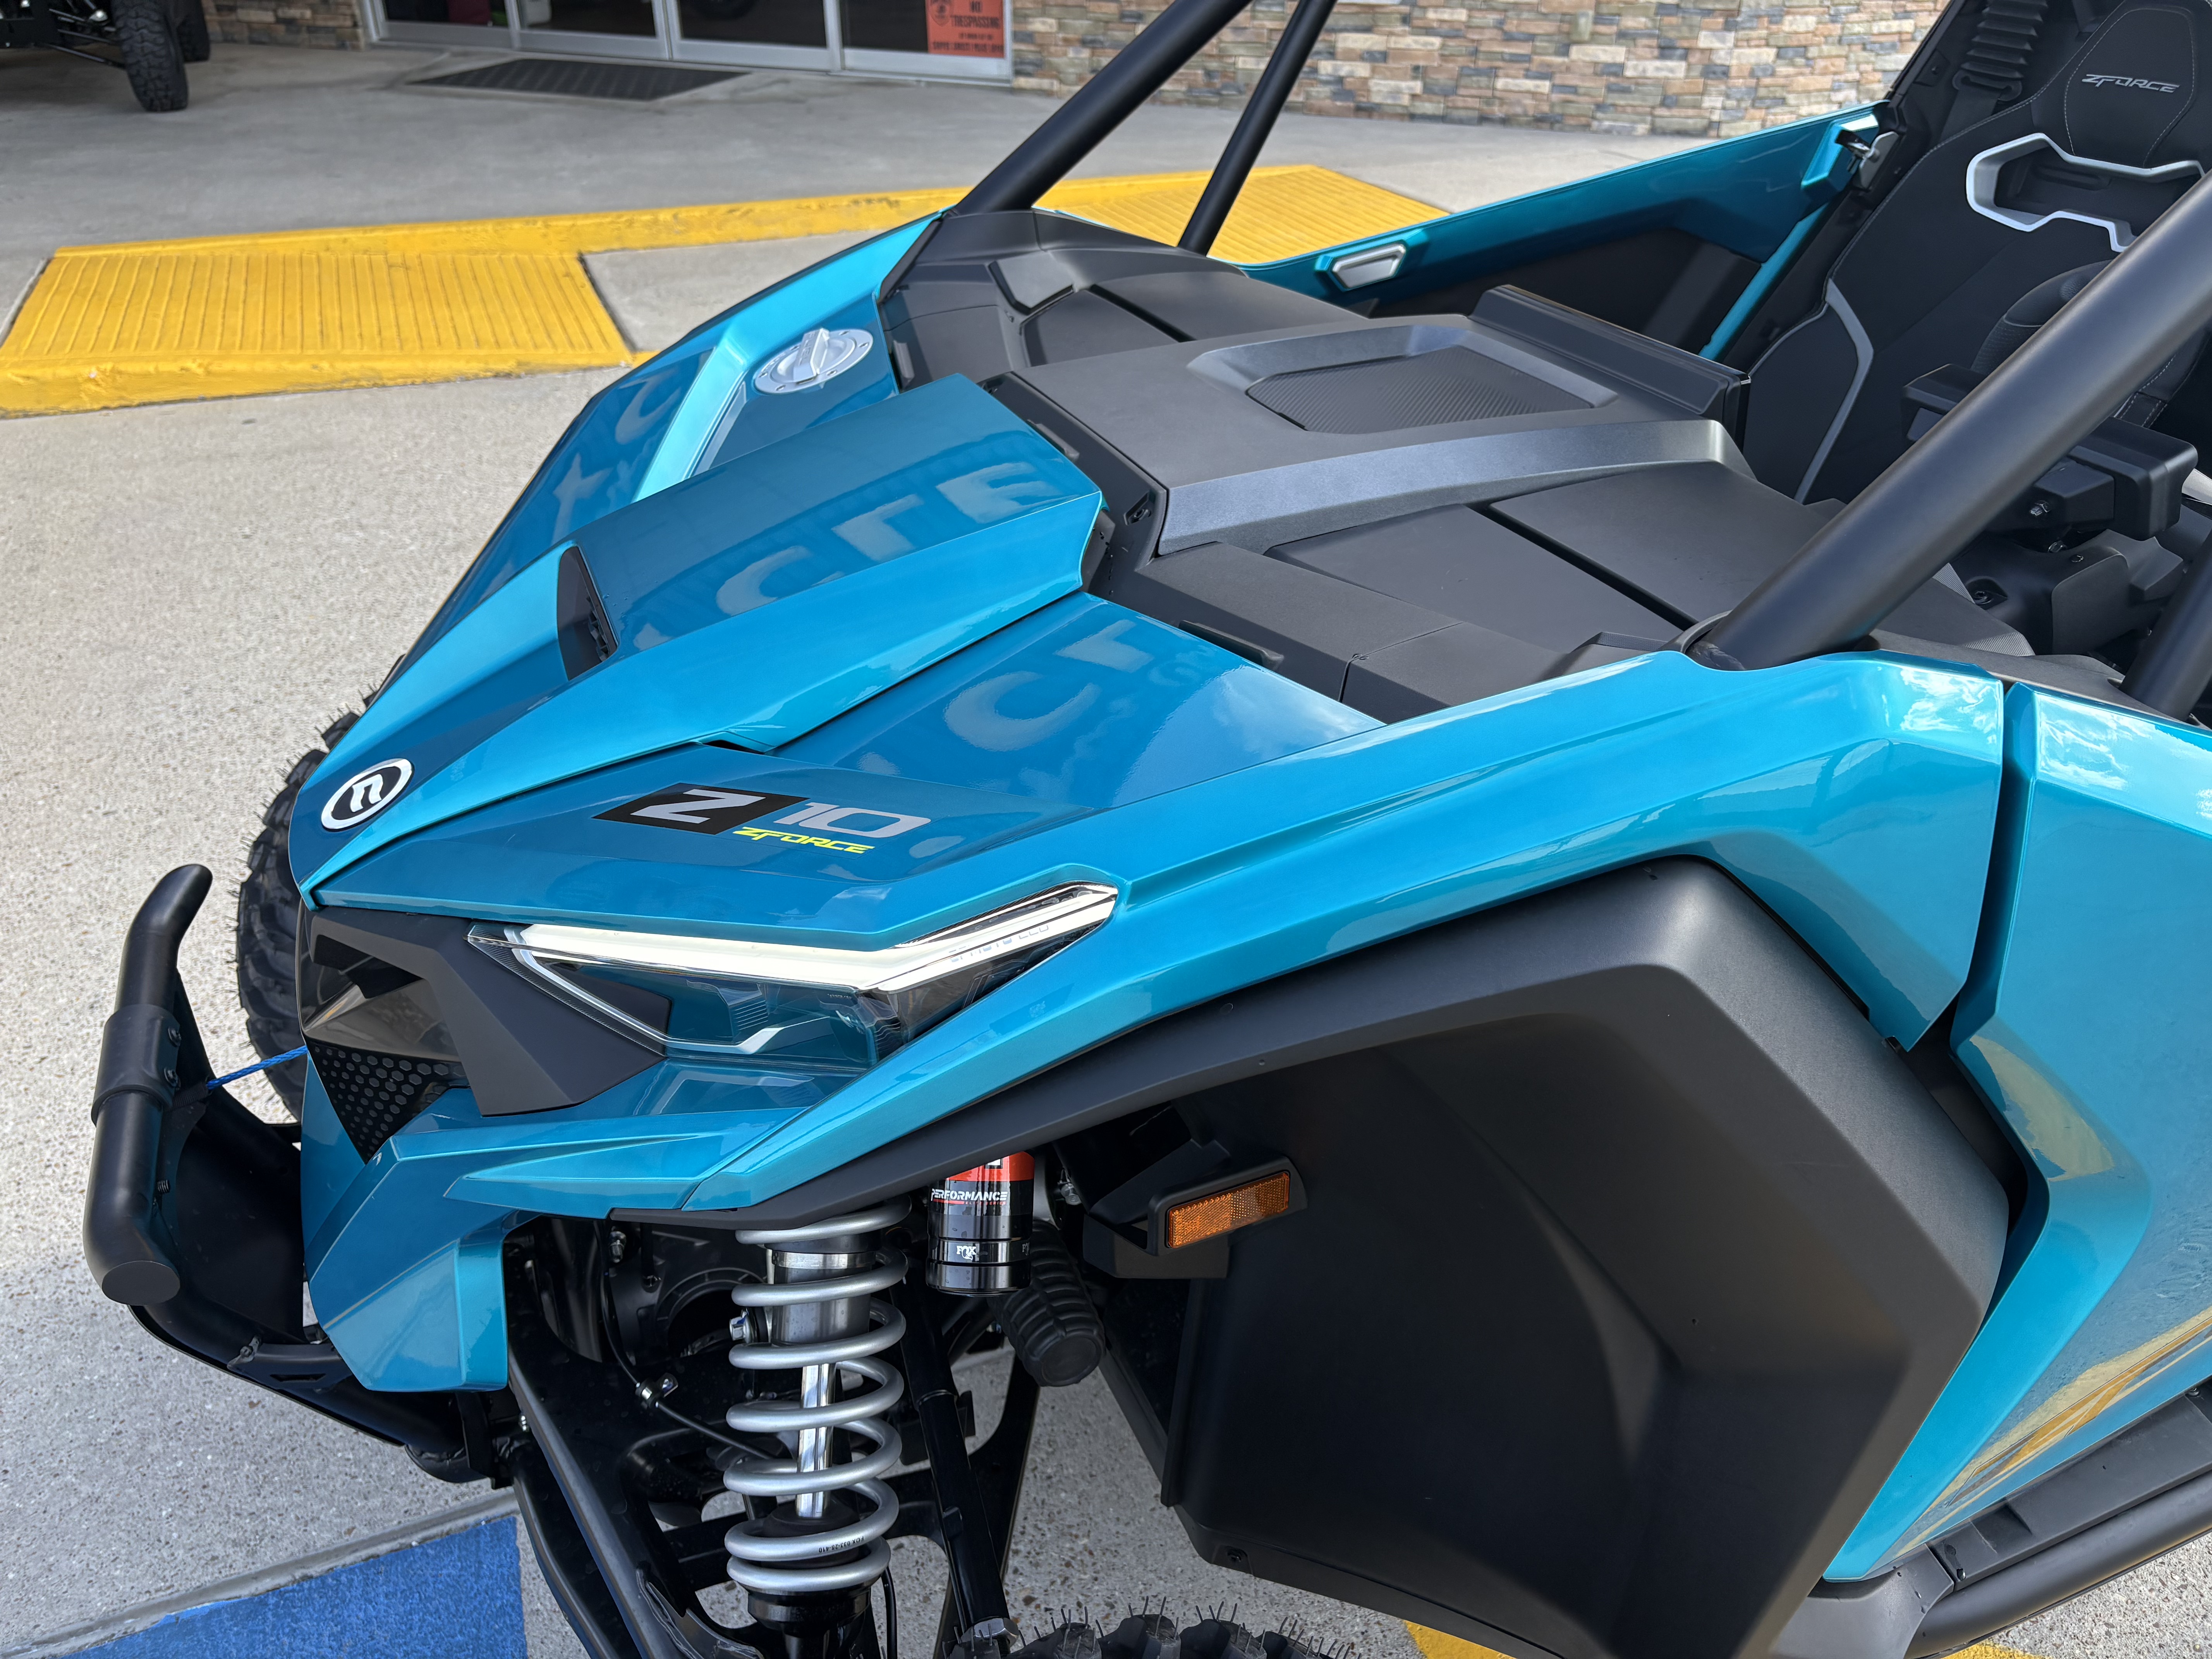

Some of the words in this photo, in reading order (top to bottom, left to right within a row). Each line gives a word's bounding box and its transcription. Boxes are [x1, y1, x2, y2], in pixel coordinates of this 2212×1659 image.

[951, 15, 1000, 29] TRESPASSING
[2081, 74, 2181, 93] ZFORCE
[630, 789, 766, 824] Z
[773, 802, 932, 838] 10
[732, 826, 876, 854] ZFORCE
[931, 1188, 1008, 1201] PERFORMANCE
[956, 1245, 977, 1261] FOX
[852, 1536, 864, 1544] FOX
